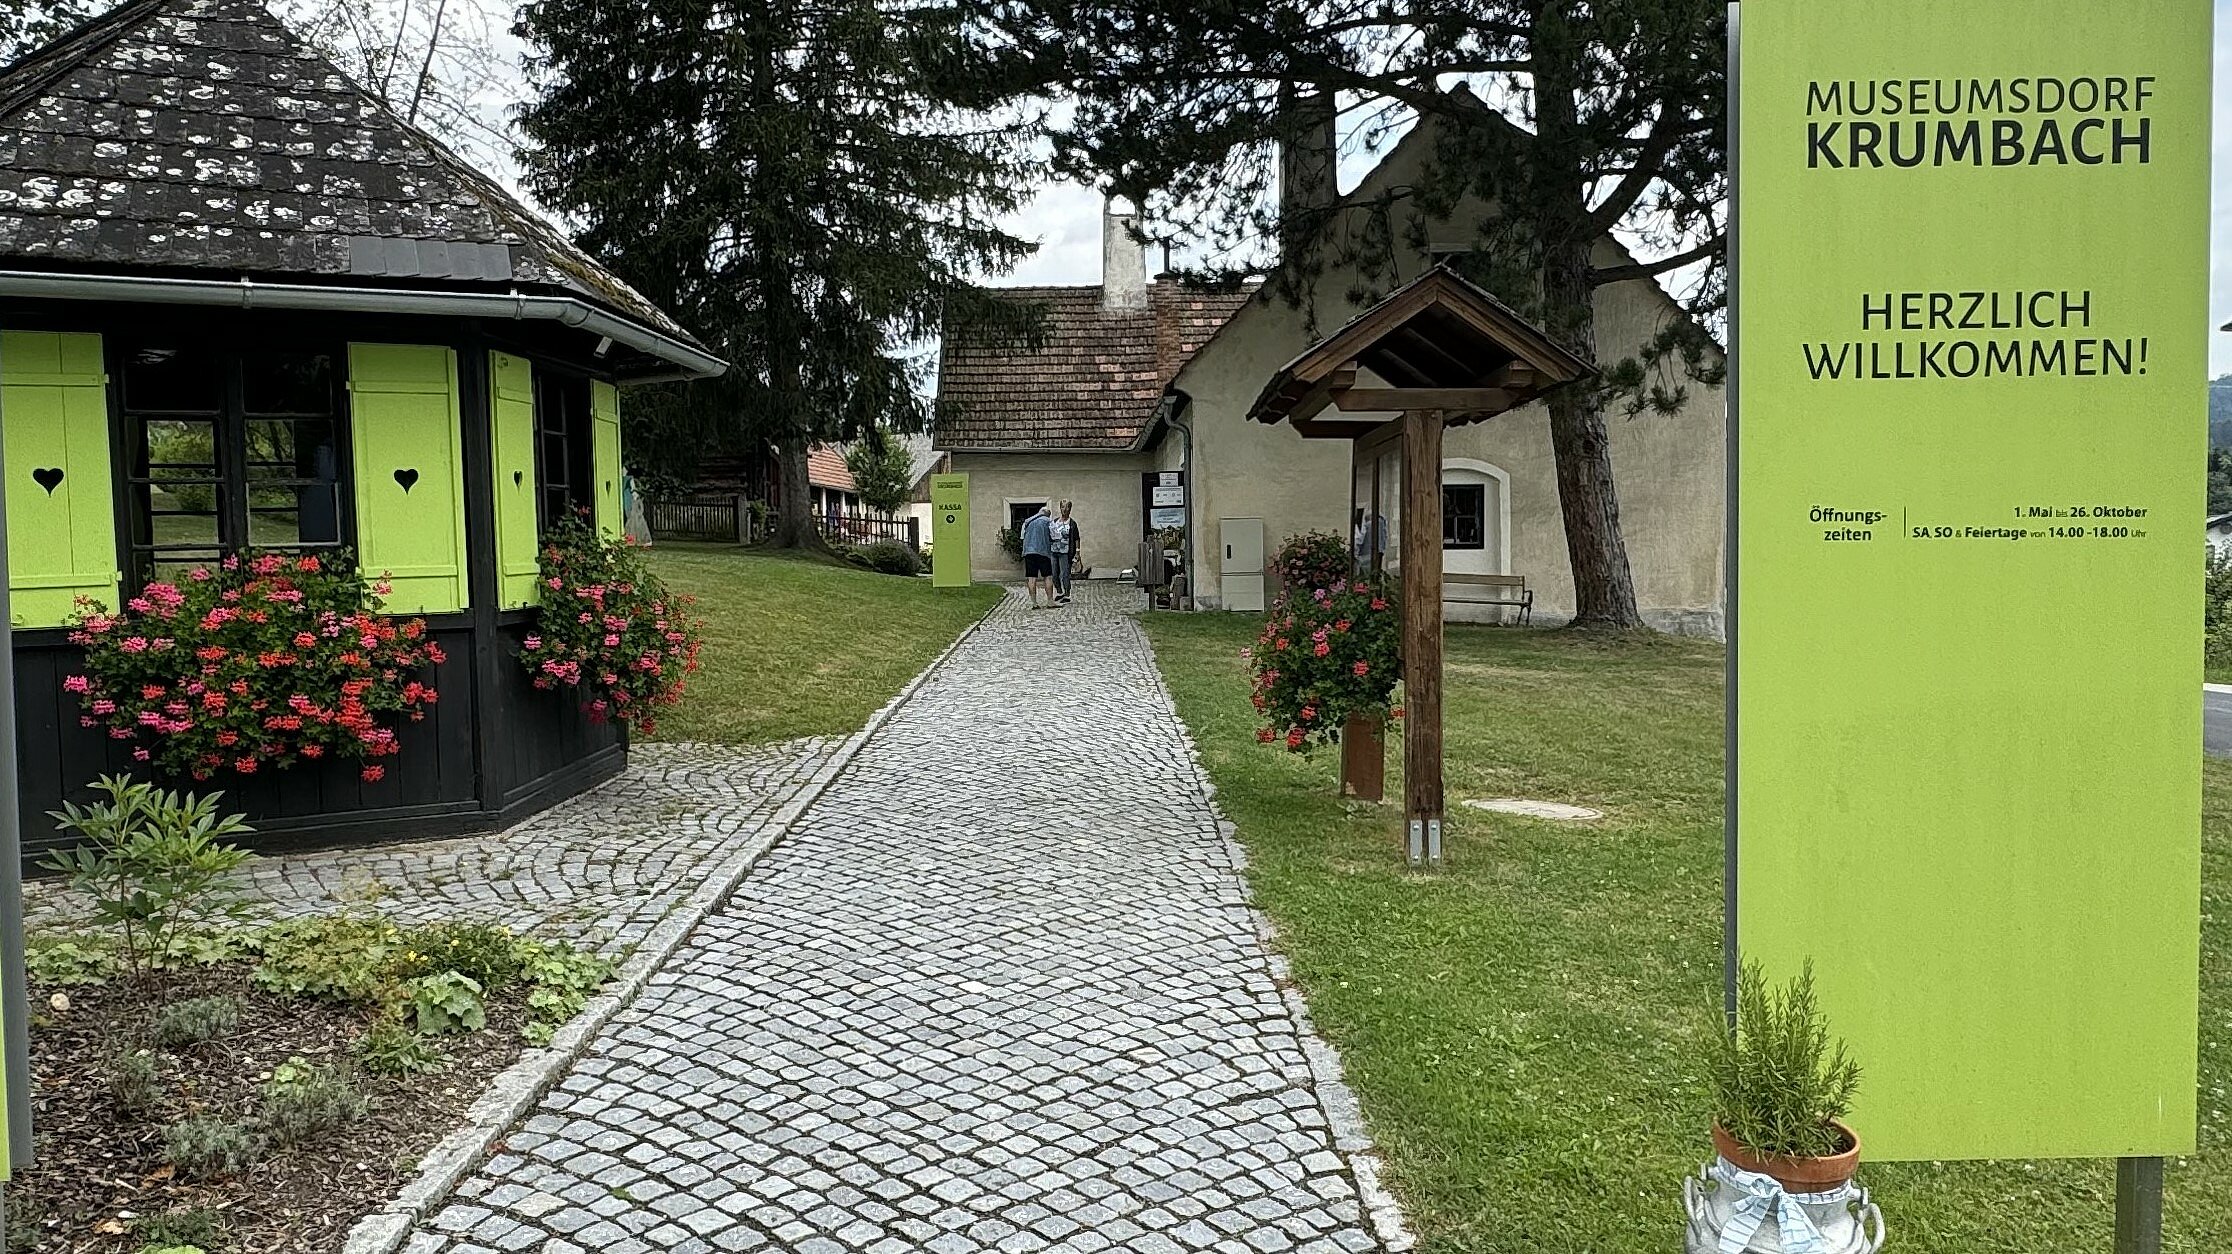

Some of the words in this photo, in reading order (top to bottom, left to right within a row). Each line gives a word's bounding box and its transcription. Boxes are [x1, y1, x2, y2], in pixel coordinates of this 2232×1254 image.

[1806, 76, 2156, 116] MUSEUMSDORF
[1807, 117, 2151, 169] KRUMBACH
[1862, 290, 2091, 331] HERZLICH
[1802, 337, 2149, 380] WILLKOMMEN!
[1809, 504, 1888, 525] Öffnungs-
[2014, 506, 2027, 518] 1.
[2028, 506, 2053, 518] Mai
[2070, 506, 2091, 518] 26.
[2092, 506, 2148, 518] Oktober
[1824, 526, 1872, 541] zeiten
[1933, 526, 1953, 538] SO
[1955, 529, 1962, 538] &
[1964, 526, 2028, 541] Feiertage
[2030, 530, 2047, 538] von
[2130, 529, 2147, 538] Uhr
